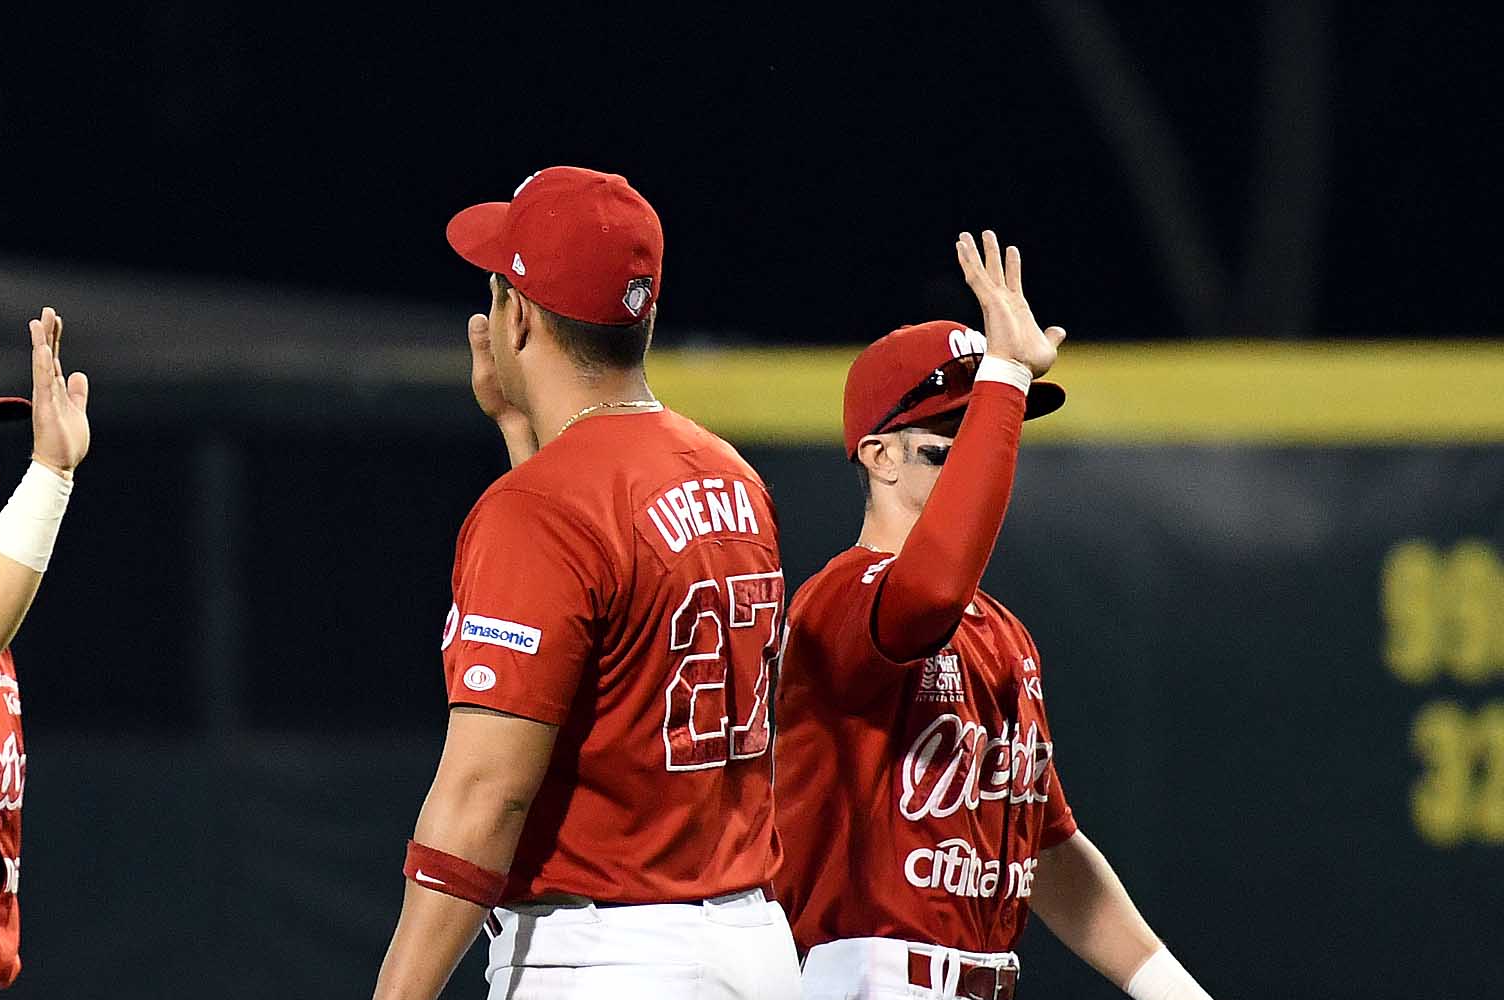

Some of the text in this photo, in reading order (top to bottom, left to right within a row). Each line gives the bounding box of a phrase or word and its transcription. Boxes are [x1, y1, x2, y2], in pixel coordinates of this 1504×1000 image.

[647, 477, 760, 553] UREÑA
[462, 620, 535, 649] Panasonic
[662, 567, 785, 772] 27
